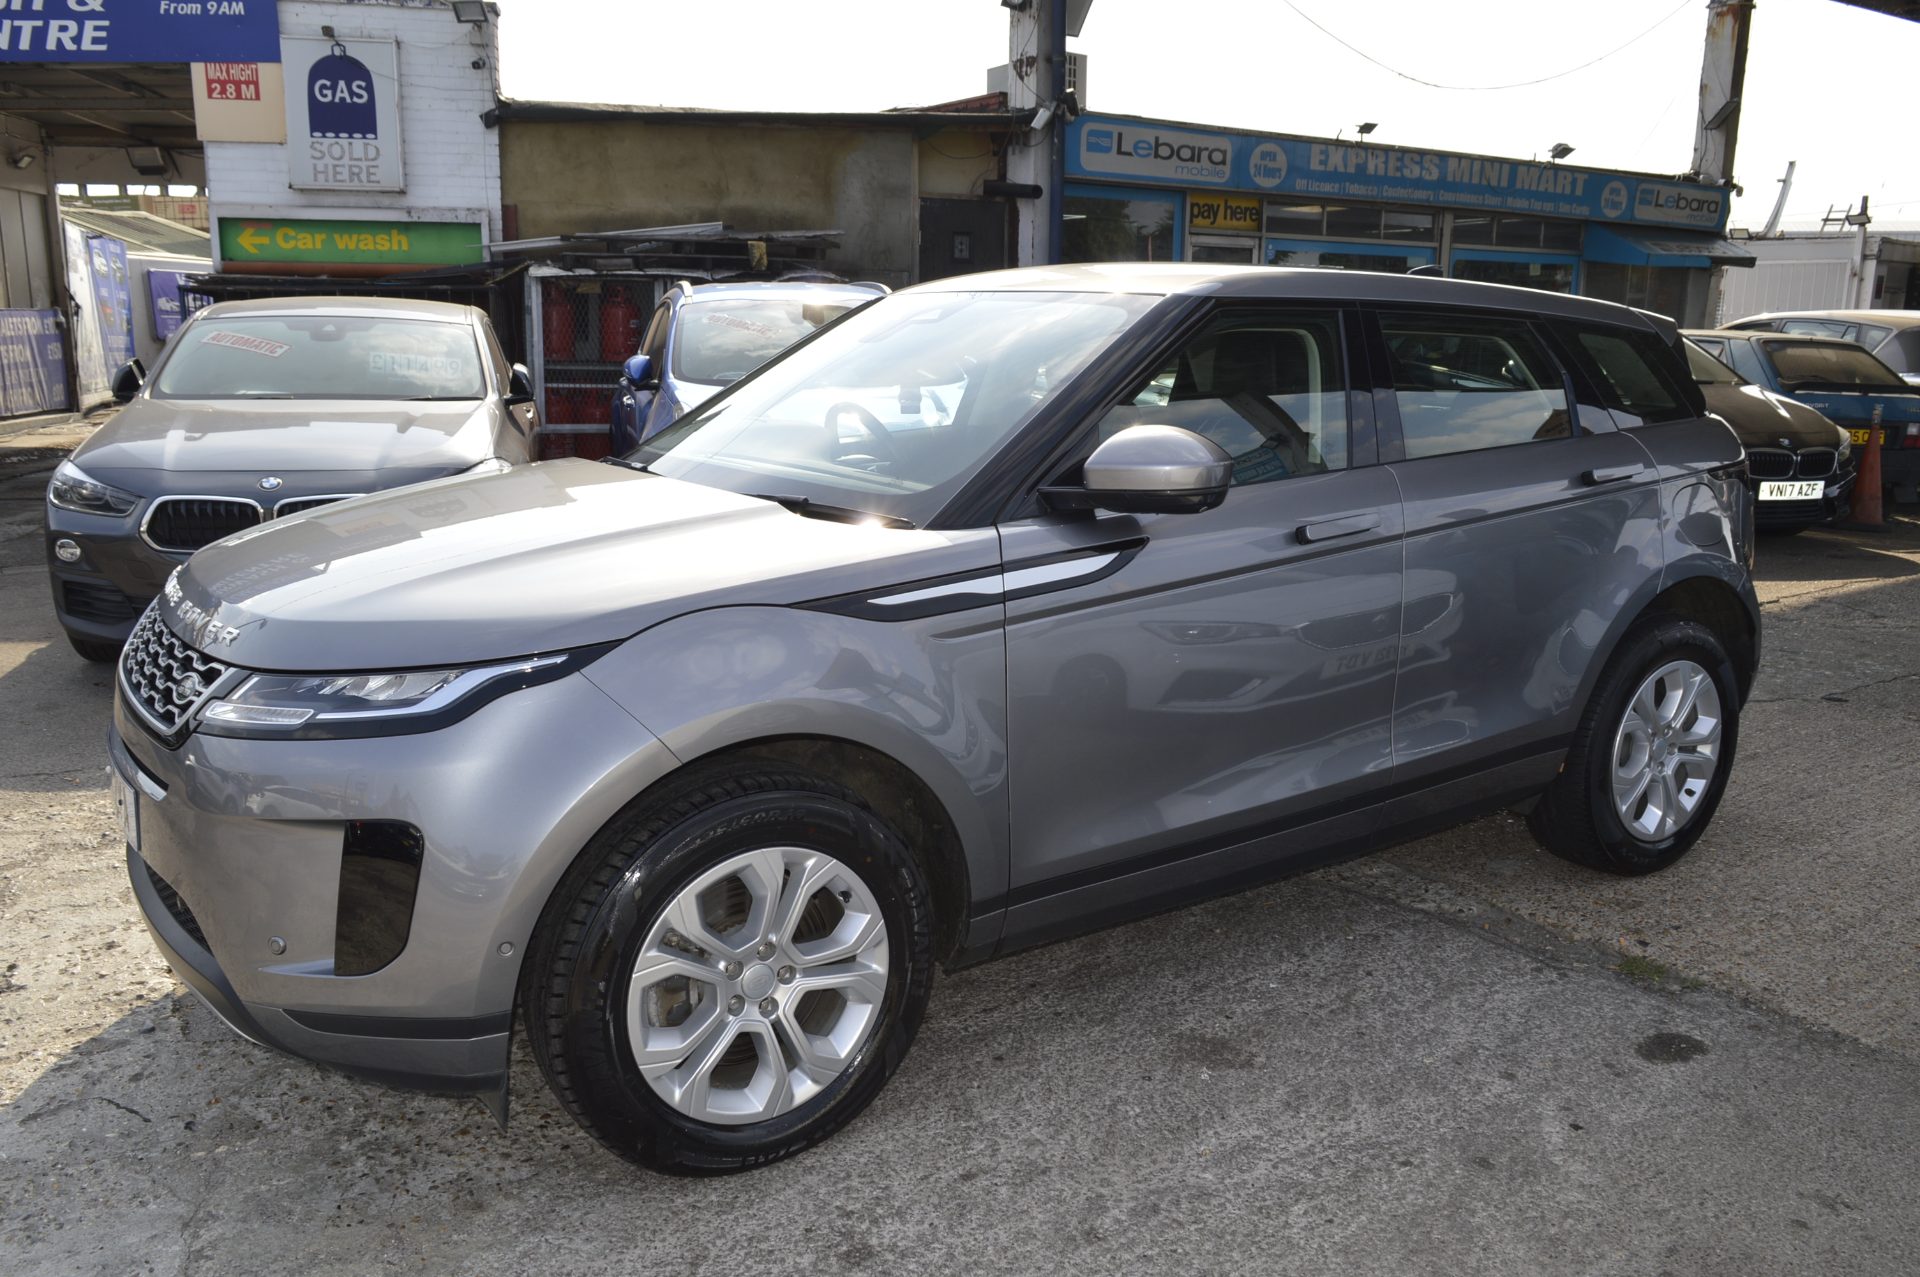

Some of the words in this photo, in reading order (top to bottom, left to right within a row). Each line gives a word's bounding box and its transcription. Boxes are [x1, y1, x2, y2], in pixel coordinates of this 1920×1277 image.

[159, 0, 202, 15] From
[206, 1, 245, 16] 9AM
[207, 63, 228, 81] MAX
[229, 64, 258, 82] HIGHT
[211, 83, 237, 99] 2.8
[241, 84, 256, 100] M
[313, 79, 369, 104] GAS
[309, 141, 381, 162] SOLD
[1115, 131, 1228, 166] Lebara
[1259, 149, 1278, 163] OPEN
[312, 163, 381, 185] HERE
[1174, 163, 1226, 179] mobile
[1253, 163, 1263, 178] 24
[1310, 142, 1441, 181] EXPRESS
[1446, 157, 1511, 188] MINI
[1515, 165, 1589, 197] MART
[1345, 182, 1378, 195] Tobacco
[1189, 201, 1221, 225] pay
[1223, 198, 1260, 222] here
[1653, 189, 1720, 214] Lebara
[275, 227, 327, 250] Car
[333, 229, 410, 251] wash
[207, 331, 284, 355] AUTOMATIC
[1768, 483, 1795, 497] VN17
[1796, 483, 1819, 497] AZF
[177, 600, 240, 647] ROVER
